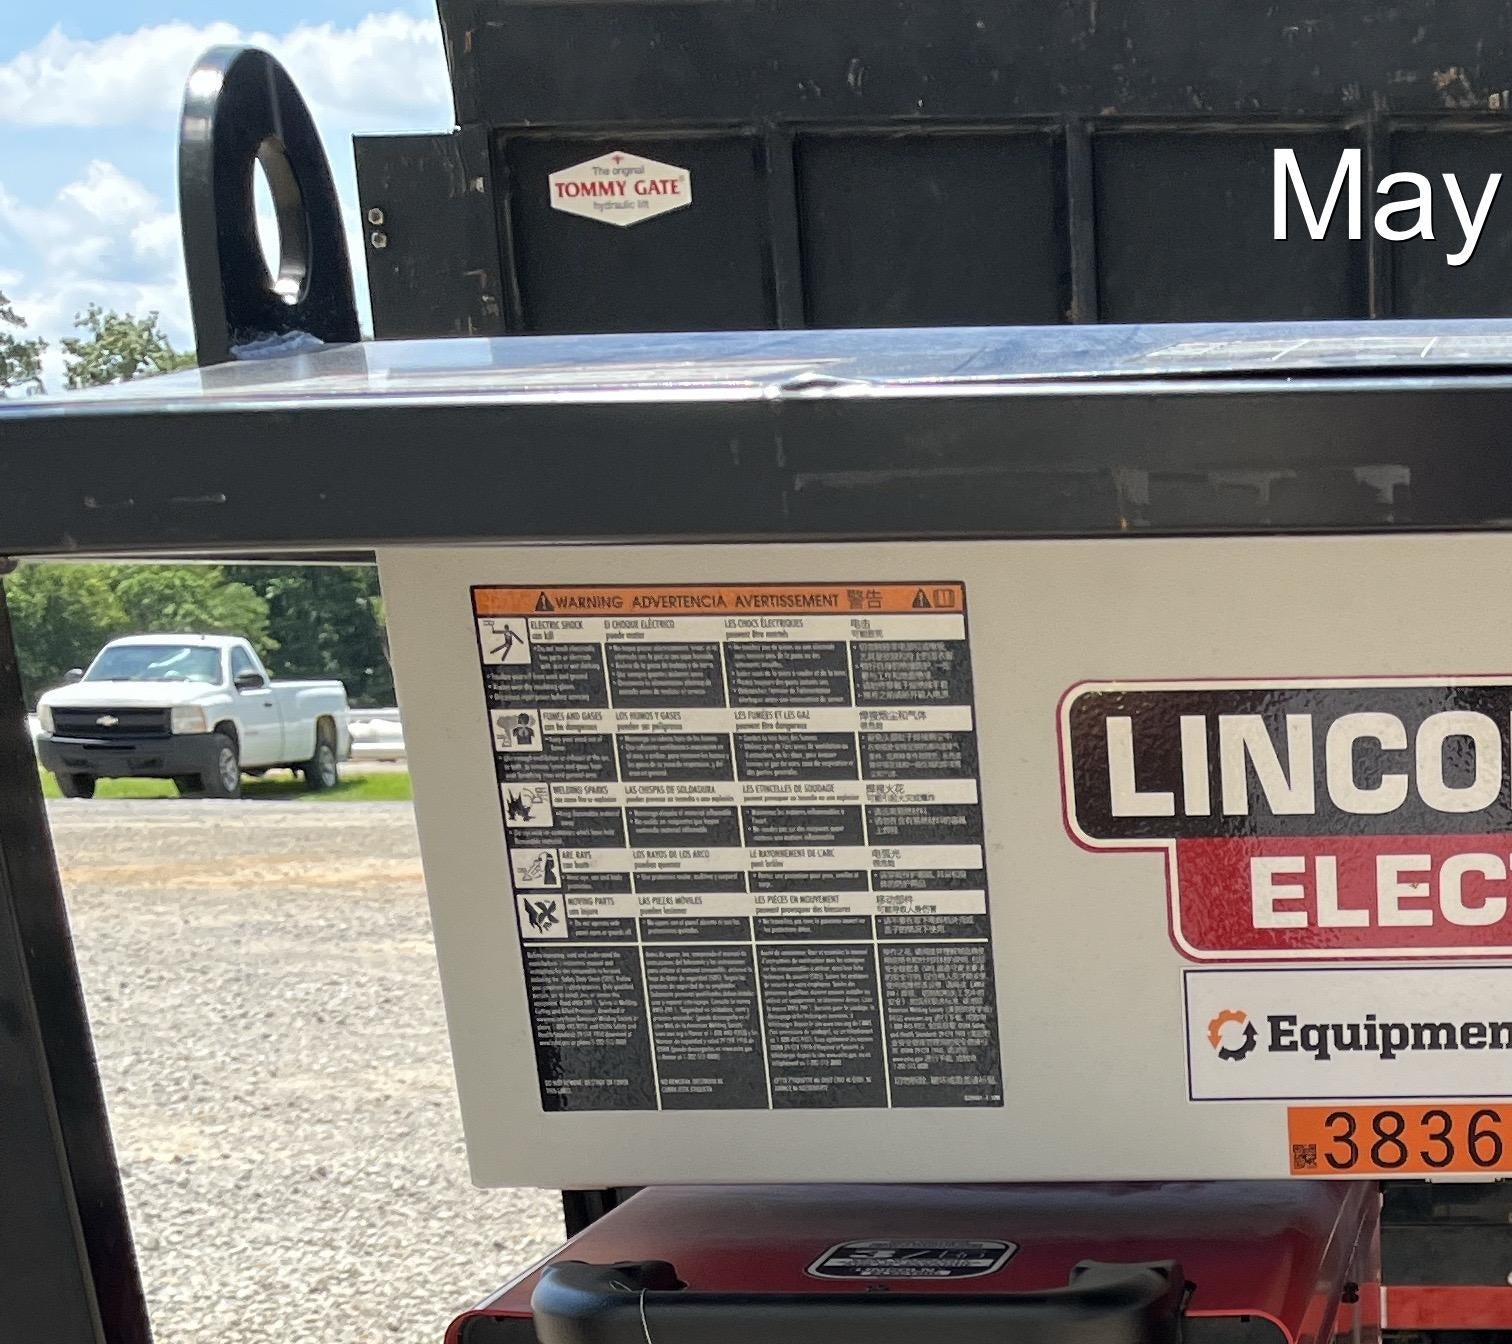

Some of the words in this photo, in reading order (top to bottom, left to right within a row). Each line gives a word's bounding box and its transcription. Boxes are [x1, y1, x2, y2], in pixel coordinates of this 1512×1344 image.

[593, 167, 609, 175] The
[612, 166, 644, 177] original
[555, 181, 627, 198] TOMMY
[635, 179, 680, 196] GATE
[593, 200, 635, 212] hydraulic
[638, 201, 649, 209] lift
[555, 595, 623, 608] WARNING
[632, 596, 727, 608] ADVERTENCIA
[735, 594, 840, 608] AVERTISSEMENT
